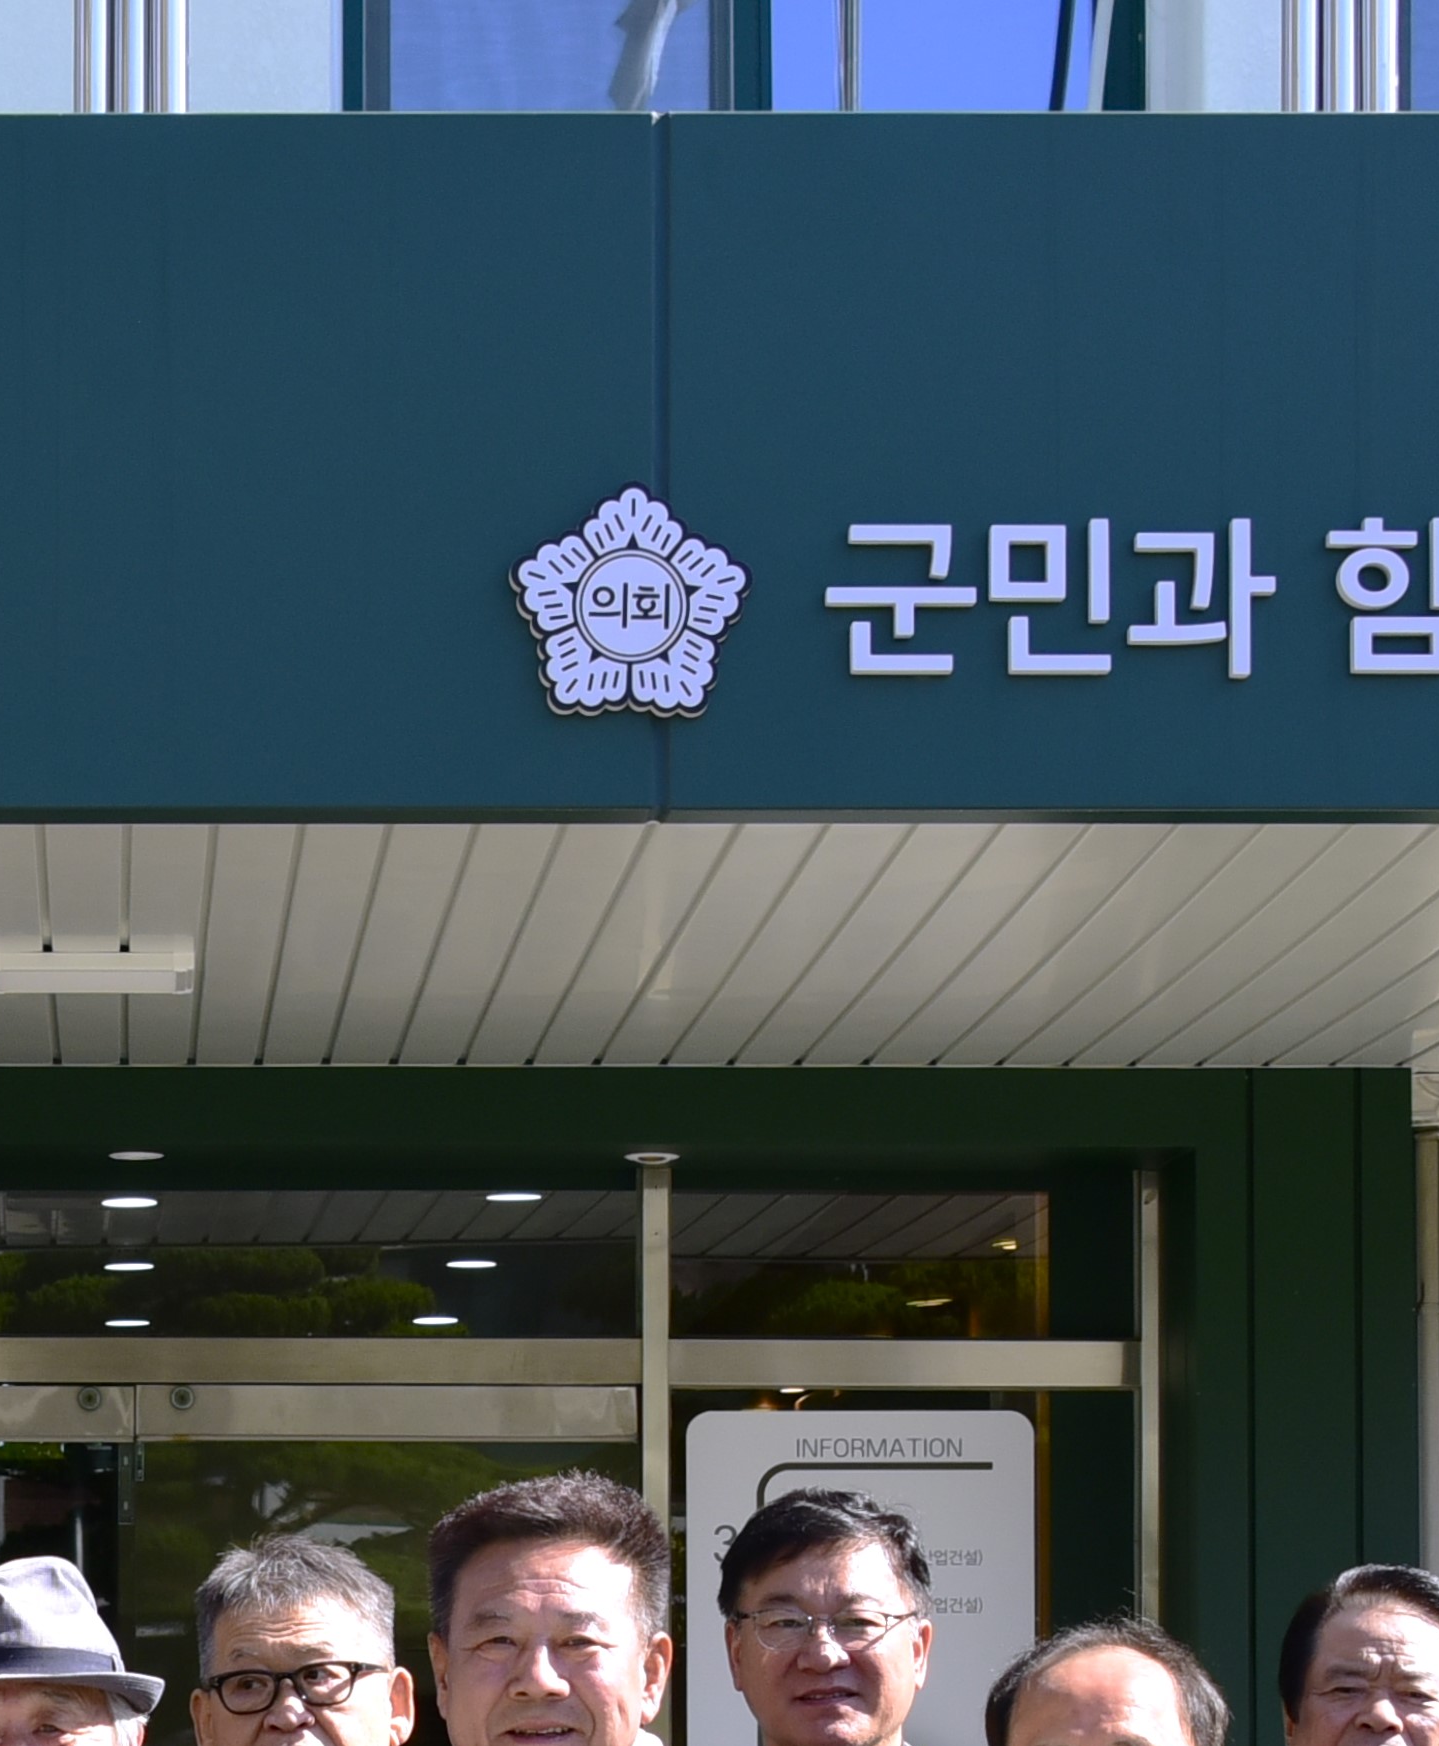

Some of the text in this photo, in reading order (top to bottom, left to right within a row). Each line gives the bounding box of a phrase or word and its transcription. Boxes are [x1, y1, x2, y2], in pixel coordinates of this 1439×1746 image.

[588, 582, 671, 630] 의회
[827, 519, 1275, 675] 군민과
[795, 1437, 963, 1459] INFORMATION
